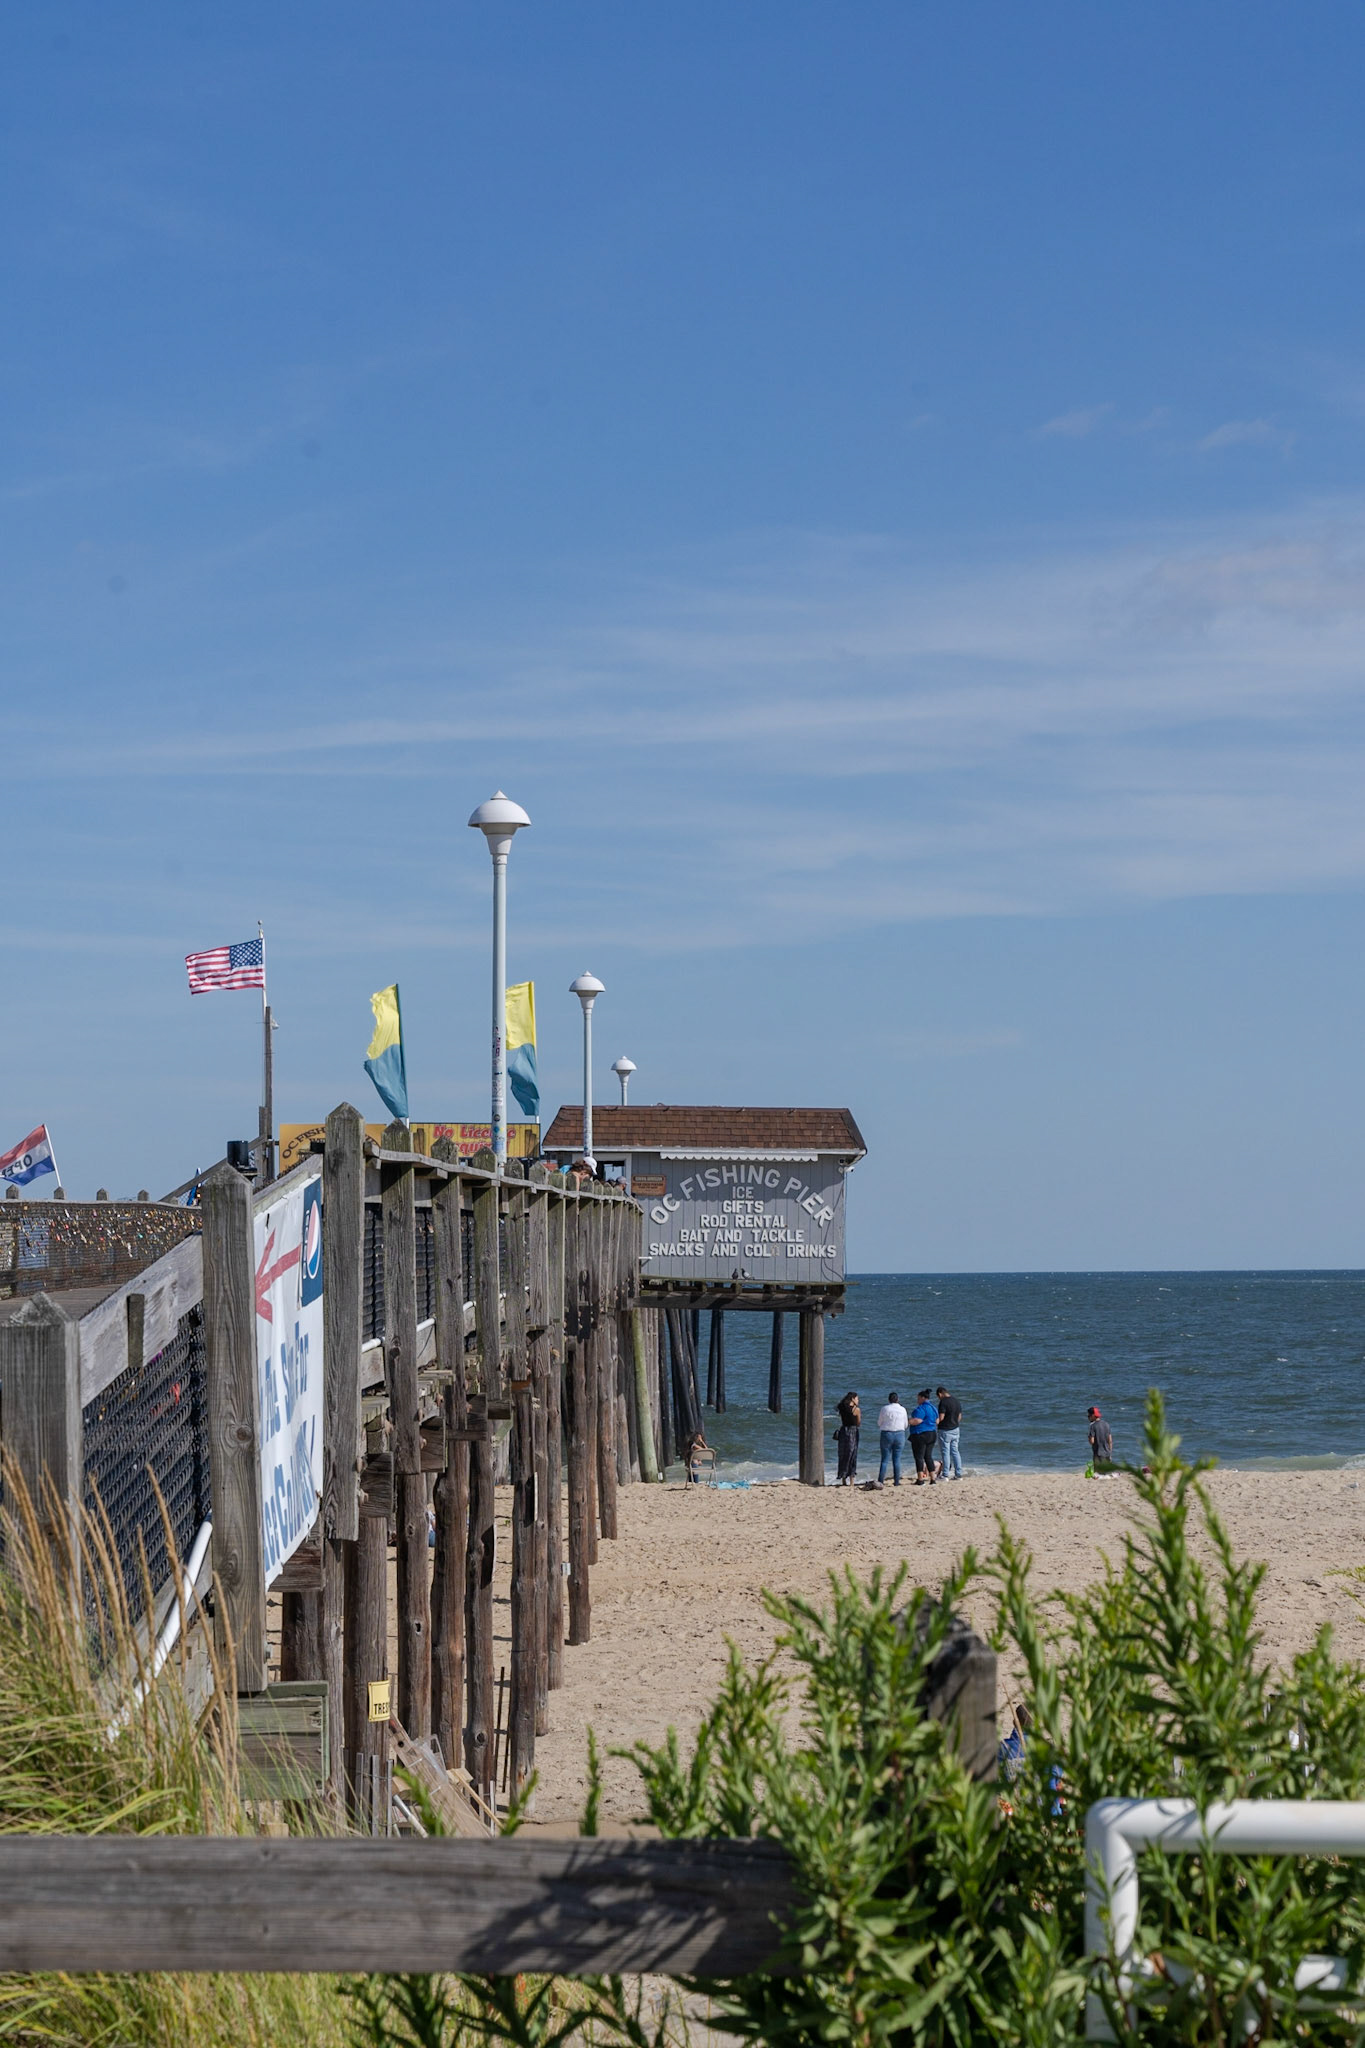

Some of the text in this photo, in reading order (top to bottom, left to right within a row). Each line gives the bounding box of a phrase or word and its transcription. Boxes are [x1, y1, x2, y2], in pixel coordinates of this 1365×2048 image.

[433, 1124, 516, 1138] No Licee
[282, 1126, 326, 1159] OC FISH
[650, 1164, 835, 1228] OC FISHING PIER
[732, 1186, 755, 1199] ICE
[723, 1200, 764, 1214] GIFTS
[701, 1215, 786, 1228] ROD RENTAL
[680, 1229, 804, 1243] BAIT AND TACKLE
[649, 1243, 704, 1256] SNACKS
[711, 1244, 738, 1257] AND
[786, 1245, 837, 1258] DRINKS
[373, 1702, 391, 1715] TRES
